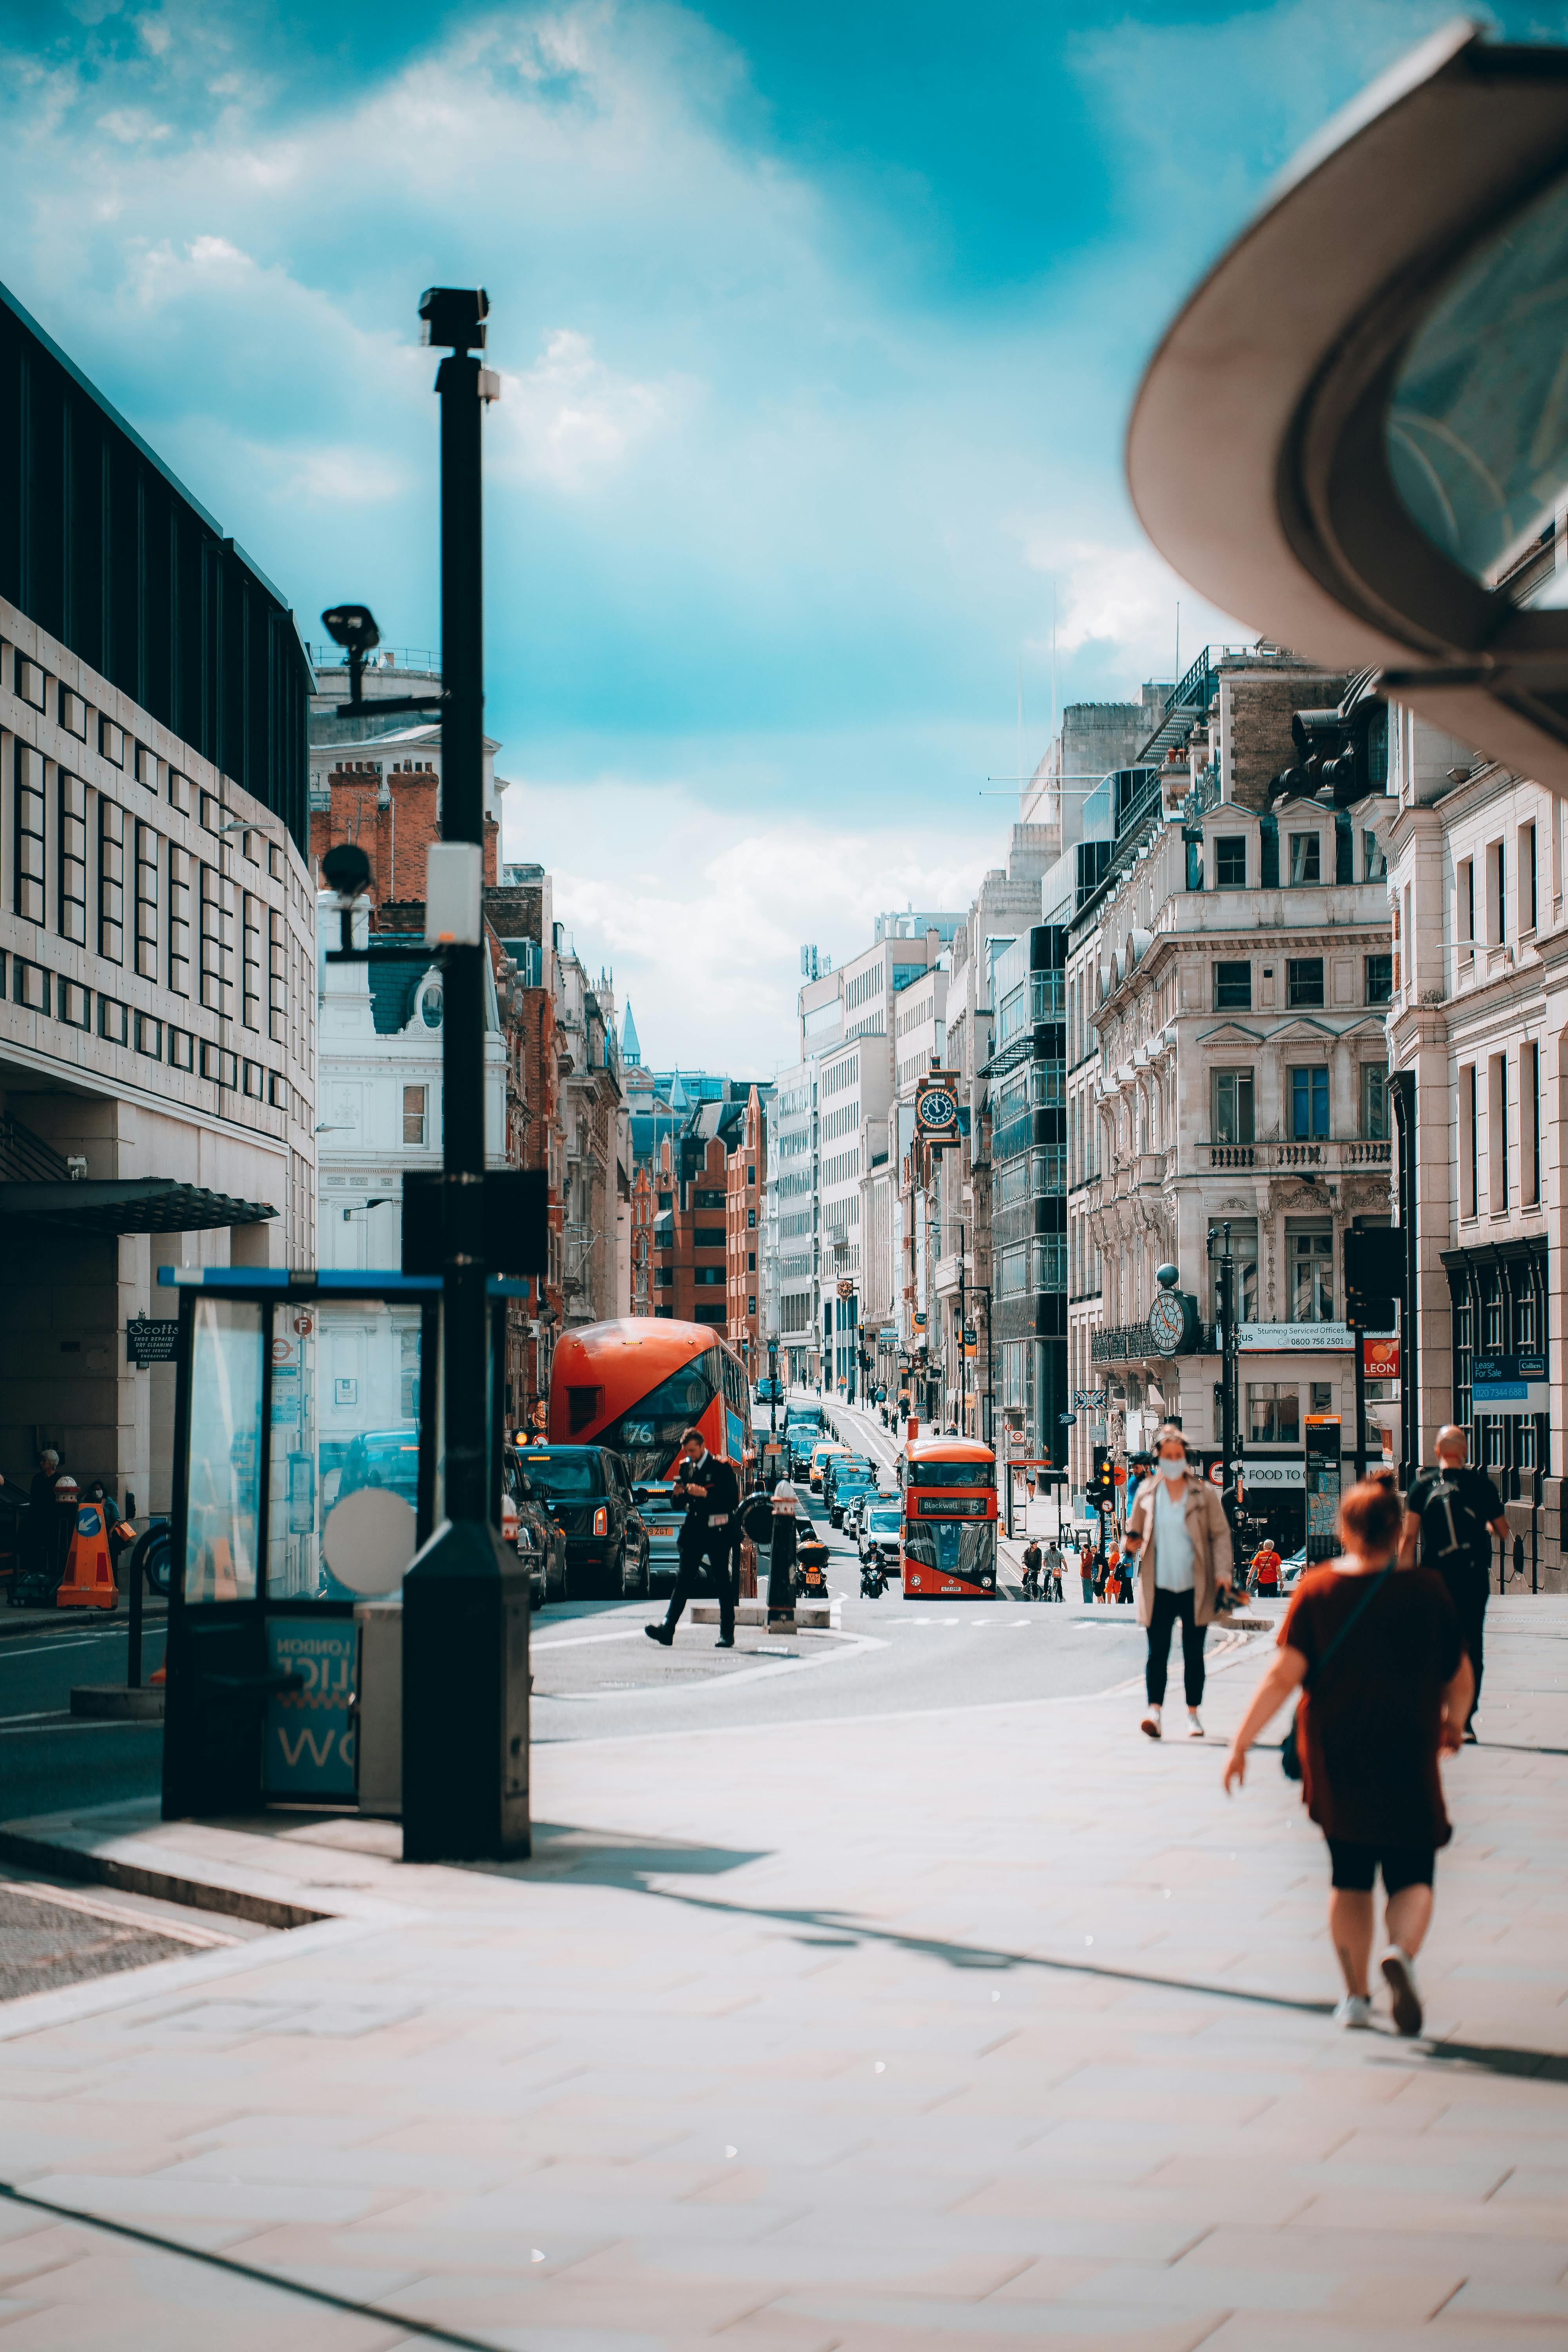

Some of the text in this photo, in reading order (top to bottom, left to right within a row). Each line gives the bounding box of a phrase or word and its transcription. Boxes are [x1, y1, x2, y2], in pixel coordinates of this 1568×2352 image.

[129, 1322, 179, 1334] Scotts
[299, 1319, 307, 1333] F
[1364, 1363, 1396, 1373] LEON
[1488, 1369, 1502, 1377] Sale
[1476, 1389, 1489, 1397] 020
[1490, 1388, 1508, 1397] 7344
[628, 1425, 652, 1443] 76
[1249, 1470, 1283, 1480] FOOD
[1285, 1470, 1300, 1480] TO
[970, 1501, 979, 1511] 15
